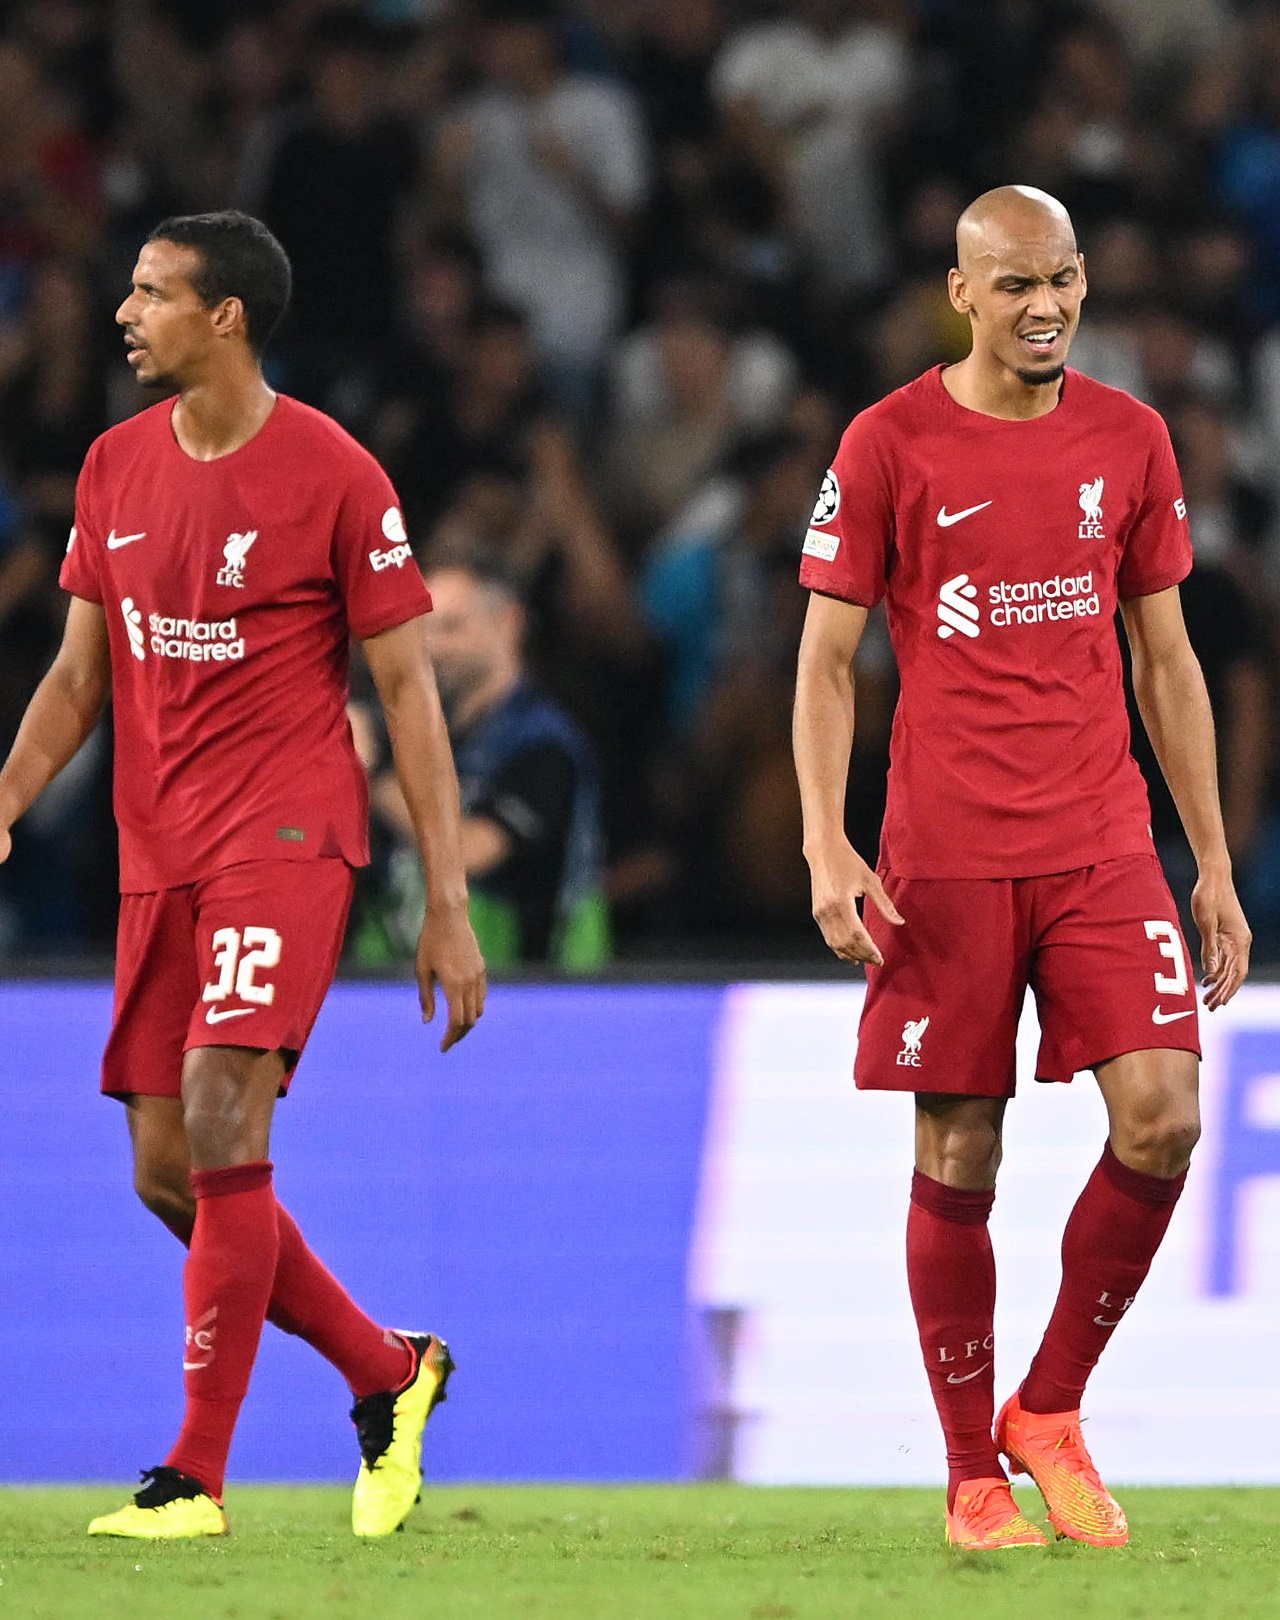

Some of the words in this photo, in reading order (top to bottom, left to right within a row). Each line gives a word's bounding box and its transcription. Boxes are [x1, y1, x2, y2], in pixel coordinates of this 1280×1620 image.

[988, 570, 1093, 604] standard
[148, 612, 237, 640] stanard
[990, 592, 1100, 627] chartered
[202, 926, 282, 1006] 32
[1143, 920, 1188, 996] 3
